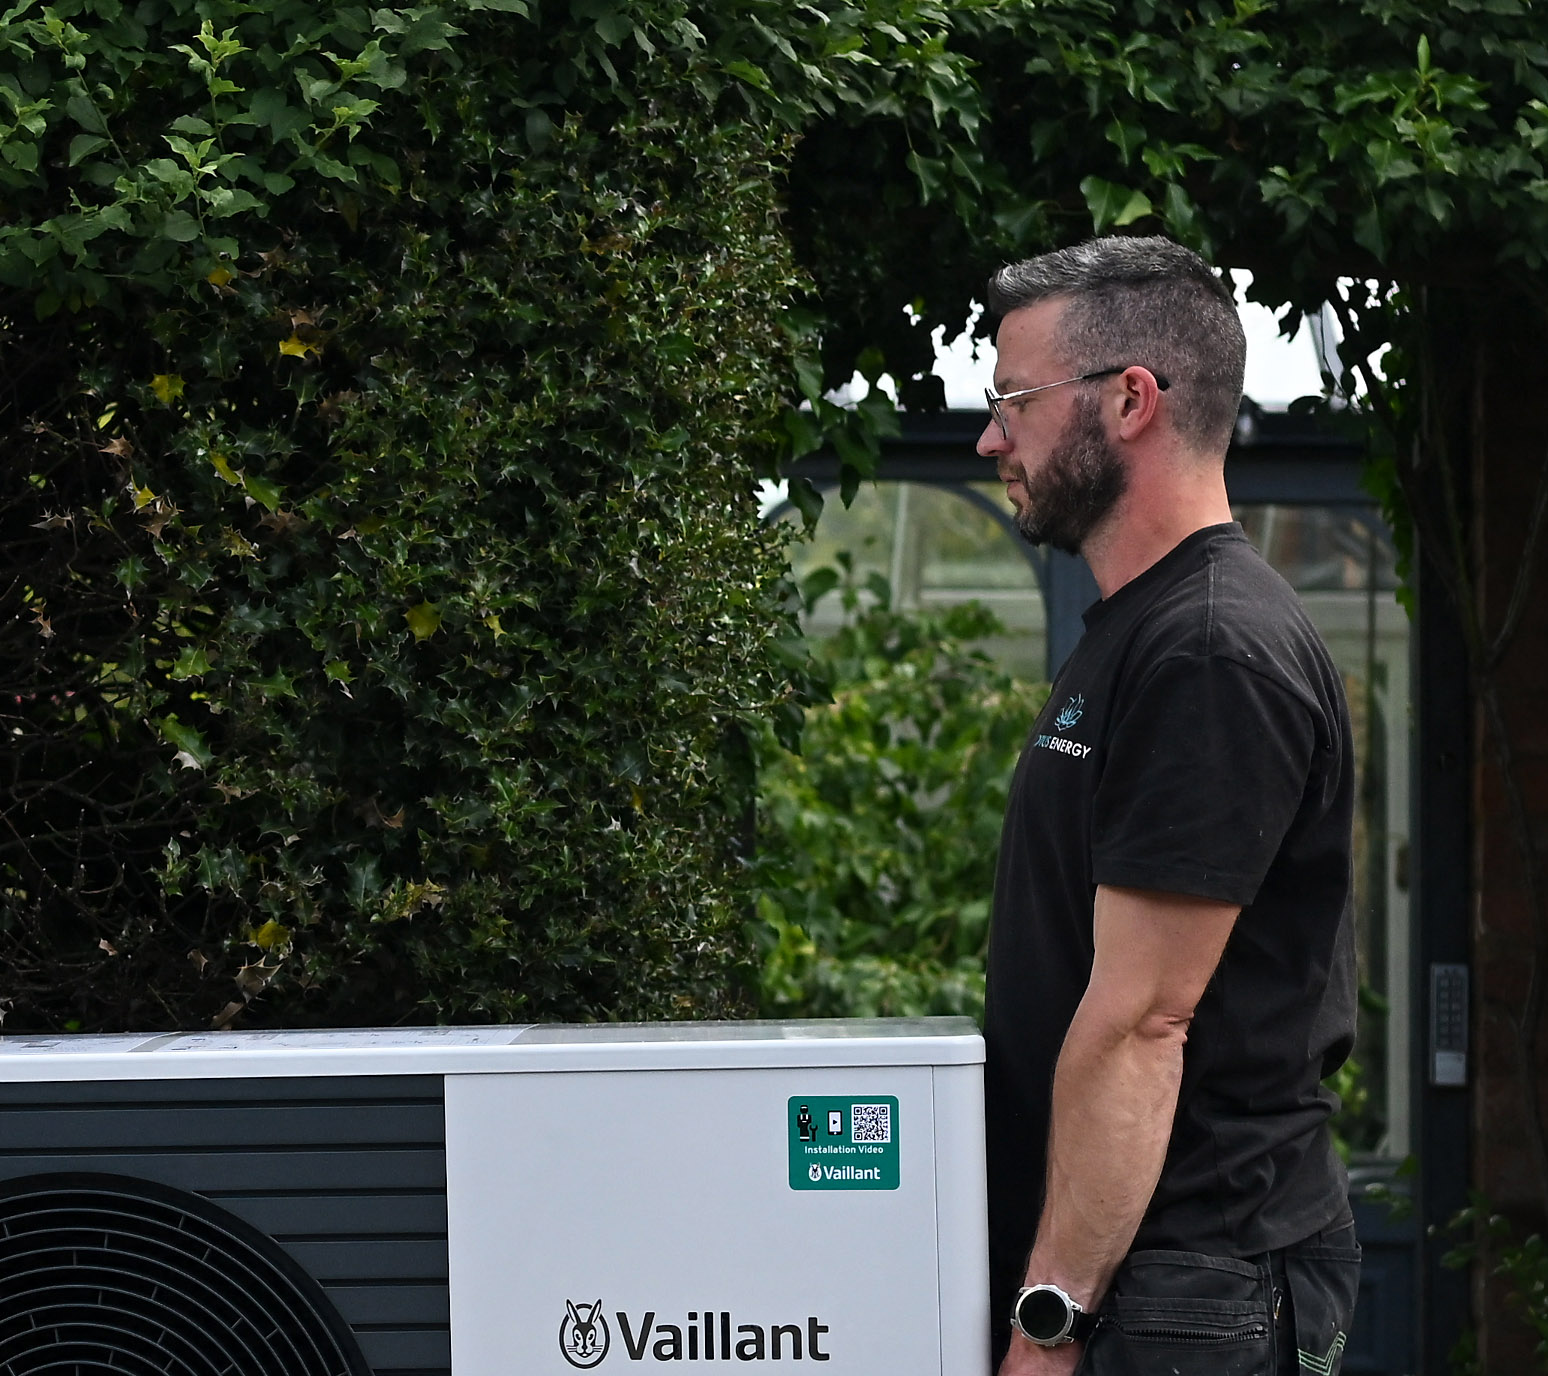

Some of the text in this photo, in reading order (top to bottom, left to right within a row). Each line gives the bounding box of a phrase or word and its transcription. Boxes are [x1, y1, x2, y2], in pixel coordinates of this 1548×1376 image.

[1049, 736, 1092, 759] ENERGY
[804, 1145, 884, 1154] Installation Video
[823, 1165, 881, 1180] Vaillant
[615, 1311, 831, 1362] Vaillant
